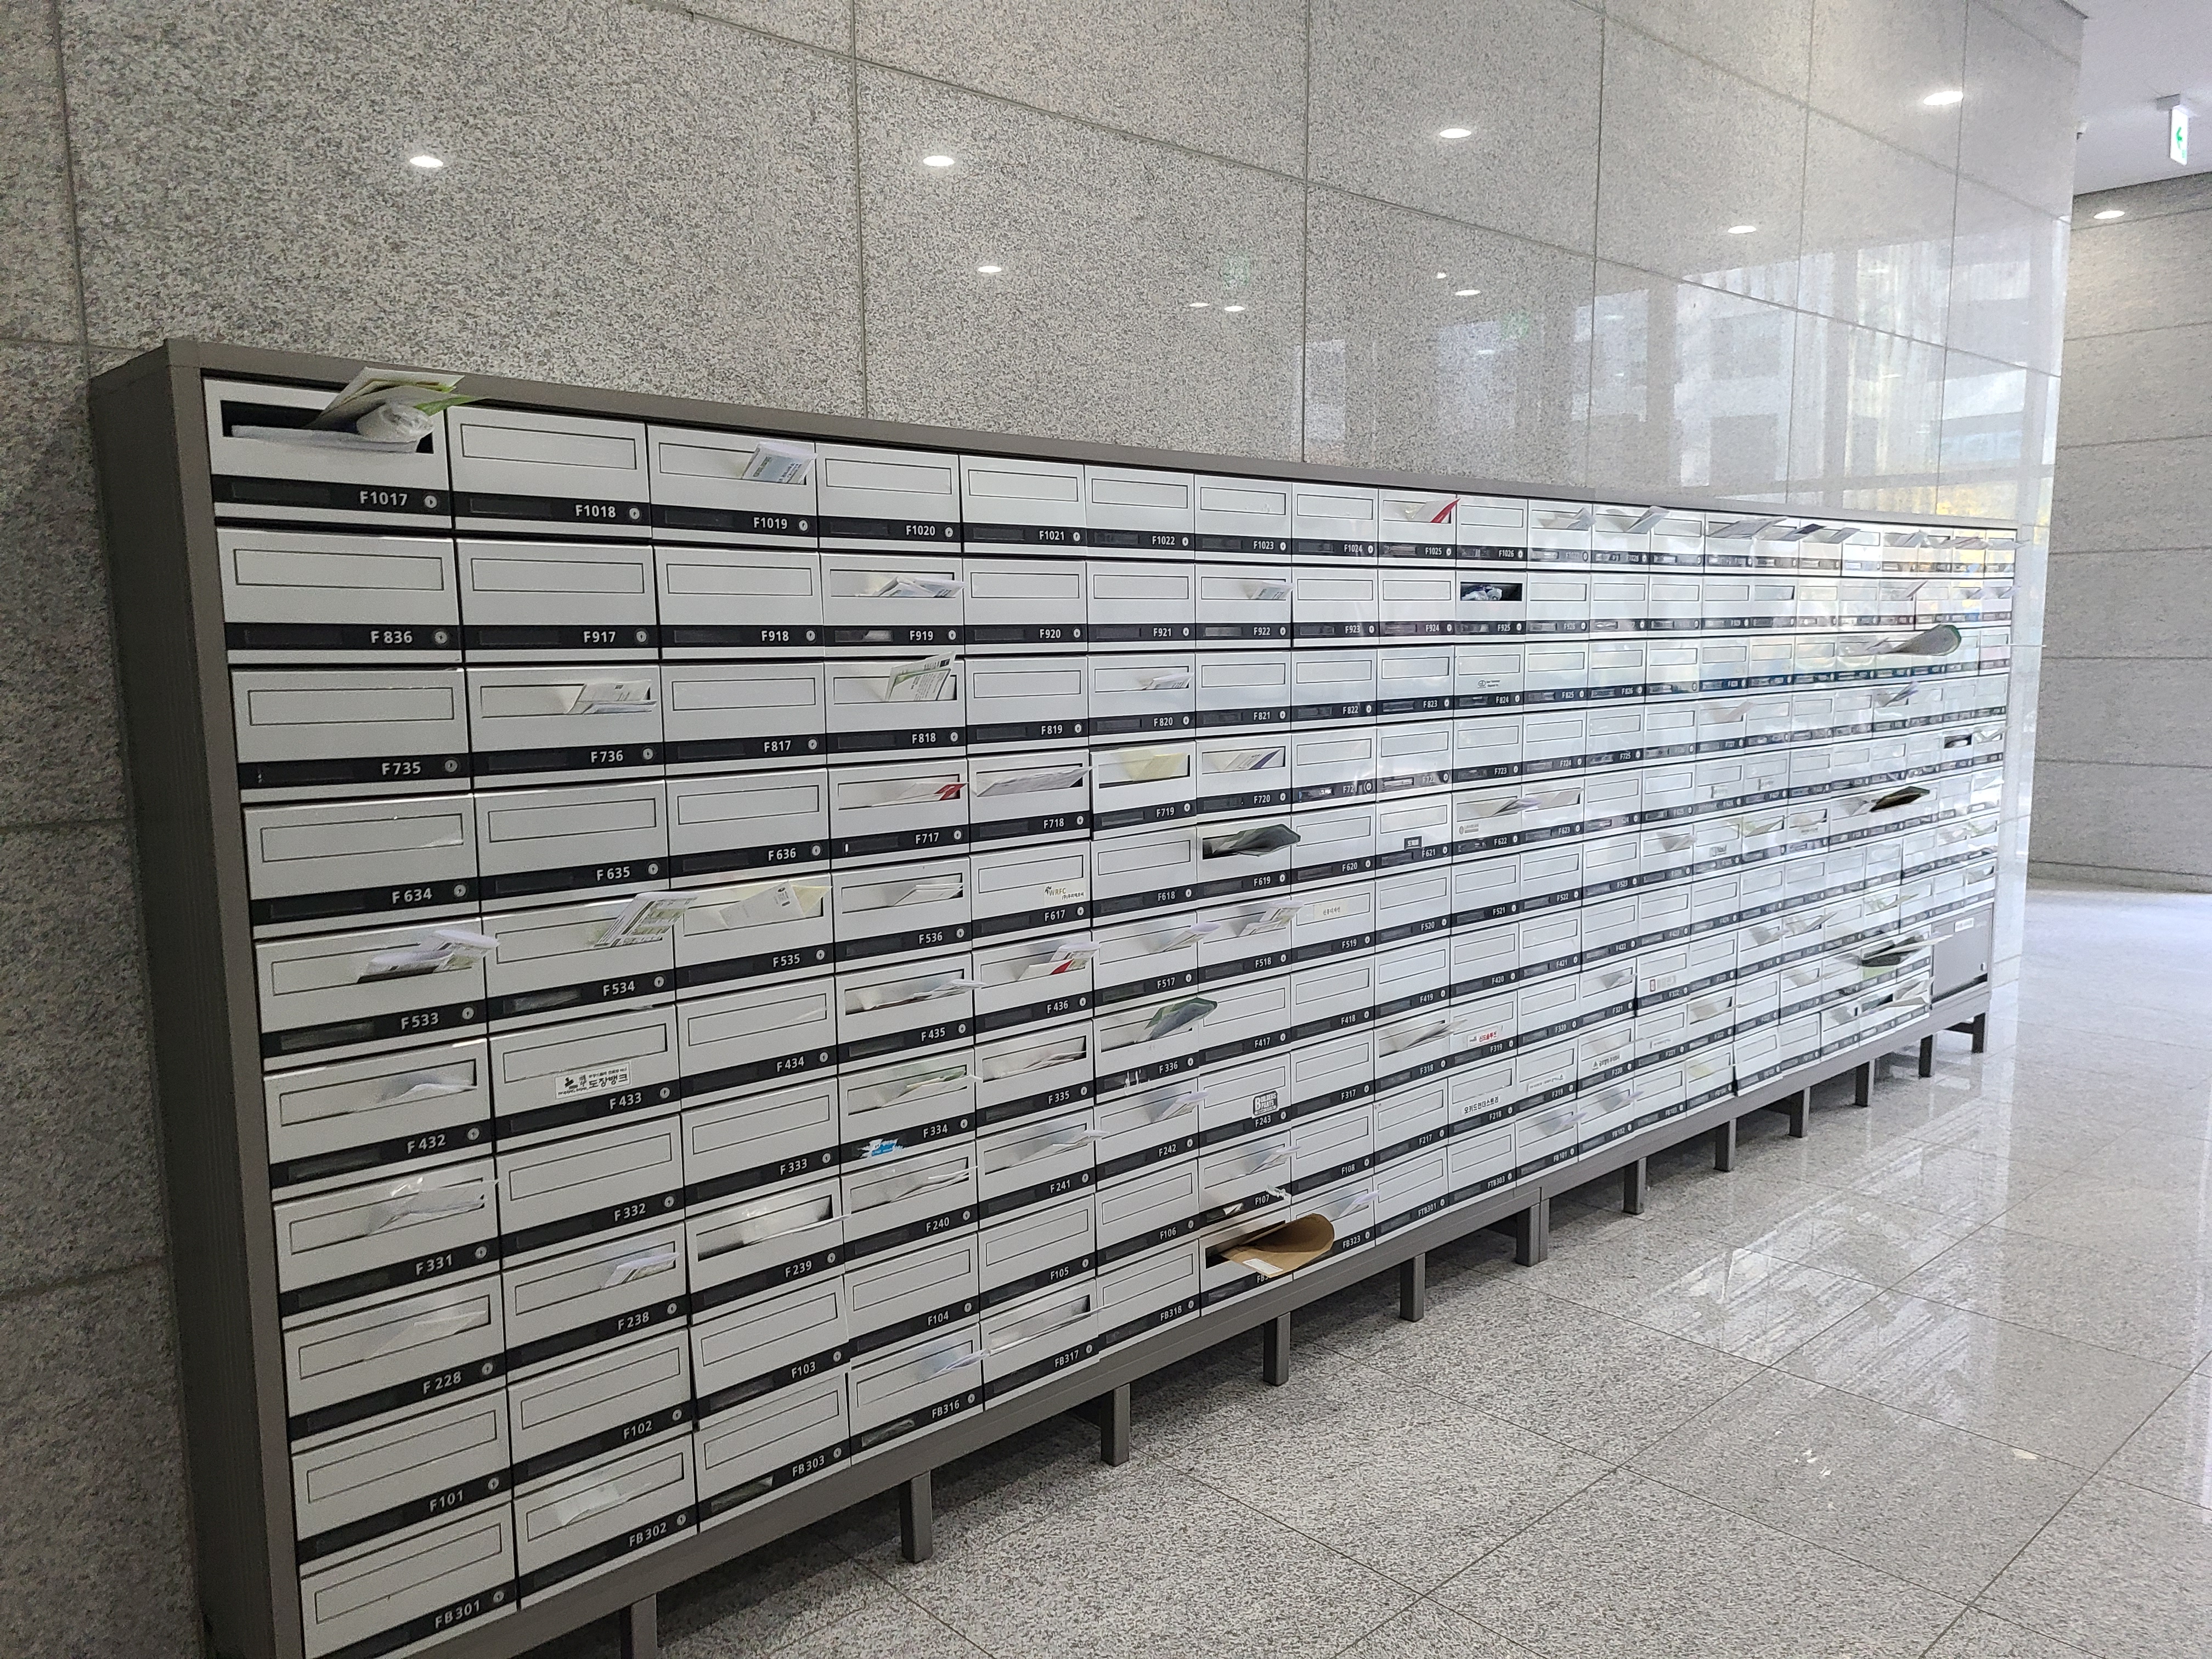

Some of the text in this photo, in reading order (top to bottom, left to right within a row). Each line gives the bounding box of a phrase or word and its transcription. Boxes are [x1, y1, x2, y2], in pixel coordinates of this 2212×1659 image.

[359, 490, 408, 506] F1017
[575, 504, 616, 518] F1018
[753, 517, 787, 529] F1019
[906, 525, 935, 536] F1020
[1039, 530, 1064, 540] F1021
[1152, 535, 1175, 545] F1022
[1253, 540, 1274, 550] F1023
[1344, 544, 1363, 553] F1024
[1425, 547, 1442, 555] F1025
[1498, 549, 1515, 558] F1026
[1153, 628, 1171, 637] F921
[1254, 627, 1271, 636] F922
[1345, 625, 1361, 634] F923
[1425, 624, 1440, 633] F924
[1497, 623, 1511, 631] F925
[370, 630, 413, 644] F836
[583, 631, 616, 643] F917
[761, 630, 789, 641] F918
[910, 630, 933, 641] F919
[1040, 629, 1061, 639] F920
[1423, 699, 1438, 708] F823
[1496, 696, 1509, 704] F824
[1254, 711, 1270, 720] F821
[1342, 704, 1359, 715] F822
[1154, 716, 1173, 727] F820
[1041, 724, 1063, 735] F819
[912, 732, 936, 744] F818
[764, 740, 791, 753] F817
[591, 750, 624, 763] F736
[381, 761, 421, 775] F735
[1494, 767, 1507, 775] F723
[1254, 794, 1271, 804] F720
[1156, 806, 1175, 818] F719
[1043, 817, 1064, 829] F718
[916, 832, 939, 844] F717
[1494, 837, 1508, 846] F622
[768, 848, 796, 861] F636
[1421, 848, 1436, 858] F621
[1342, 862, 1358, 872] F620
[596, 866, 630, 881] F635
[1254, 876, 1271, 887] F619
[392, 887, 433, 904] F634
[1049, 888, 1066, 896] WRFC
[1158, 890, 1176, 901] F618
[1556, 893, 1569, 902] F522
[1045, 909, 1065, 922] F617
[1493, 906, 1505, 916] F521
[1421, 921, 1435, 931] F520
[919, 931, 943, 944] F536
[1342, 939, 1357, 949] F519
[773, 953, 800, 968] F535
[1255, 956, 1272, 968] F518
[1157, 977, 1175, 989] F517
[1491, 975, 1505, 985] F420
[603, 980, 636, 997] F534
[1419, 993, 1434, 1003] F419
[1047, 1000, 1069, 1014] F436
[400, 1012, 439, 1030] F533
[1341, 1014, 1356, 1025] F418
[921, 1026, 945, 1042] F435
[1255, 1036, 1271, 1048] F417
[1489, 1043, 1503, 1053] F319
[776, 1056, 805, 1073] F434
[1159, 1060, 1178, 1074] F336
[1420, 1064, 1434, 1075] F318
[589, 1073, 629, 1089] 도장뱅크
[1048, 1090, 1070, 1104] F335
[1341, 1088, 1356, 1101] F317
[1551, 1088, 1564, 1098] F219
[610, 1092, 642, 1110] F433
[1255, 1115, 1271, 1127] F243
[1489, 1110, 1502, 1121] F218
[923, 1124, 948, 1138] F334
[407, 1134, 446, 1154] F432
[1419, 1133, 1432, 1146] F217
[1159, 1144, 1177, 1157] F242
[780, 1158, 807, 1176] F333
[1341, 1164, 1355, 1175] F108
[1050, 1179, 1070, 1194] F241
[1487, 1175, 1505, 1189] FTB303
[1255, 1195, 1270, 1206] F107
[614, 1203, 646, 1222] F332
[1418, 1202, 1436, 1217] FTB301
[926, 1216, 950, 1232] F240
[1160, 1228, 1177, 1240] F106
[1342, 1235, 1361, 1249] FB323
[415, 1254, 452, 1276] F331
[785, 1260, 812, 1278] F239
[1050, 1266, 1069, 1279] F105
[928, 1311, 949, 1326] F104
[1160, 1305, 1182, 1322] FB318
[618, 1311, 650, 1331] F238
[1055, 1349, 1079, 1368] FB317
[791, 1361, 816, 1379] F103
[423, 1370, 461, 1395] F228
[932, 1399, 960, 1419] FB316
[623, 1420, 652, 1440] F102
[792, 1454, 825, 1477] FB303
[430, 1489, 463, 1513] F101
[629, 1521, 667, 1547] FB302
[435, 1599, 479, 1629] FB301
